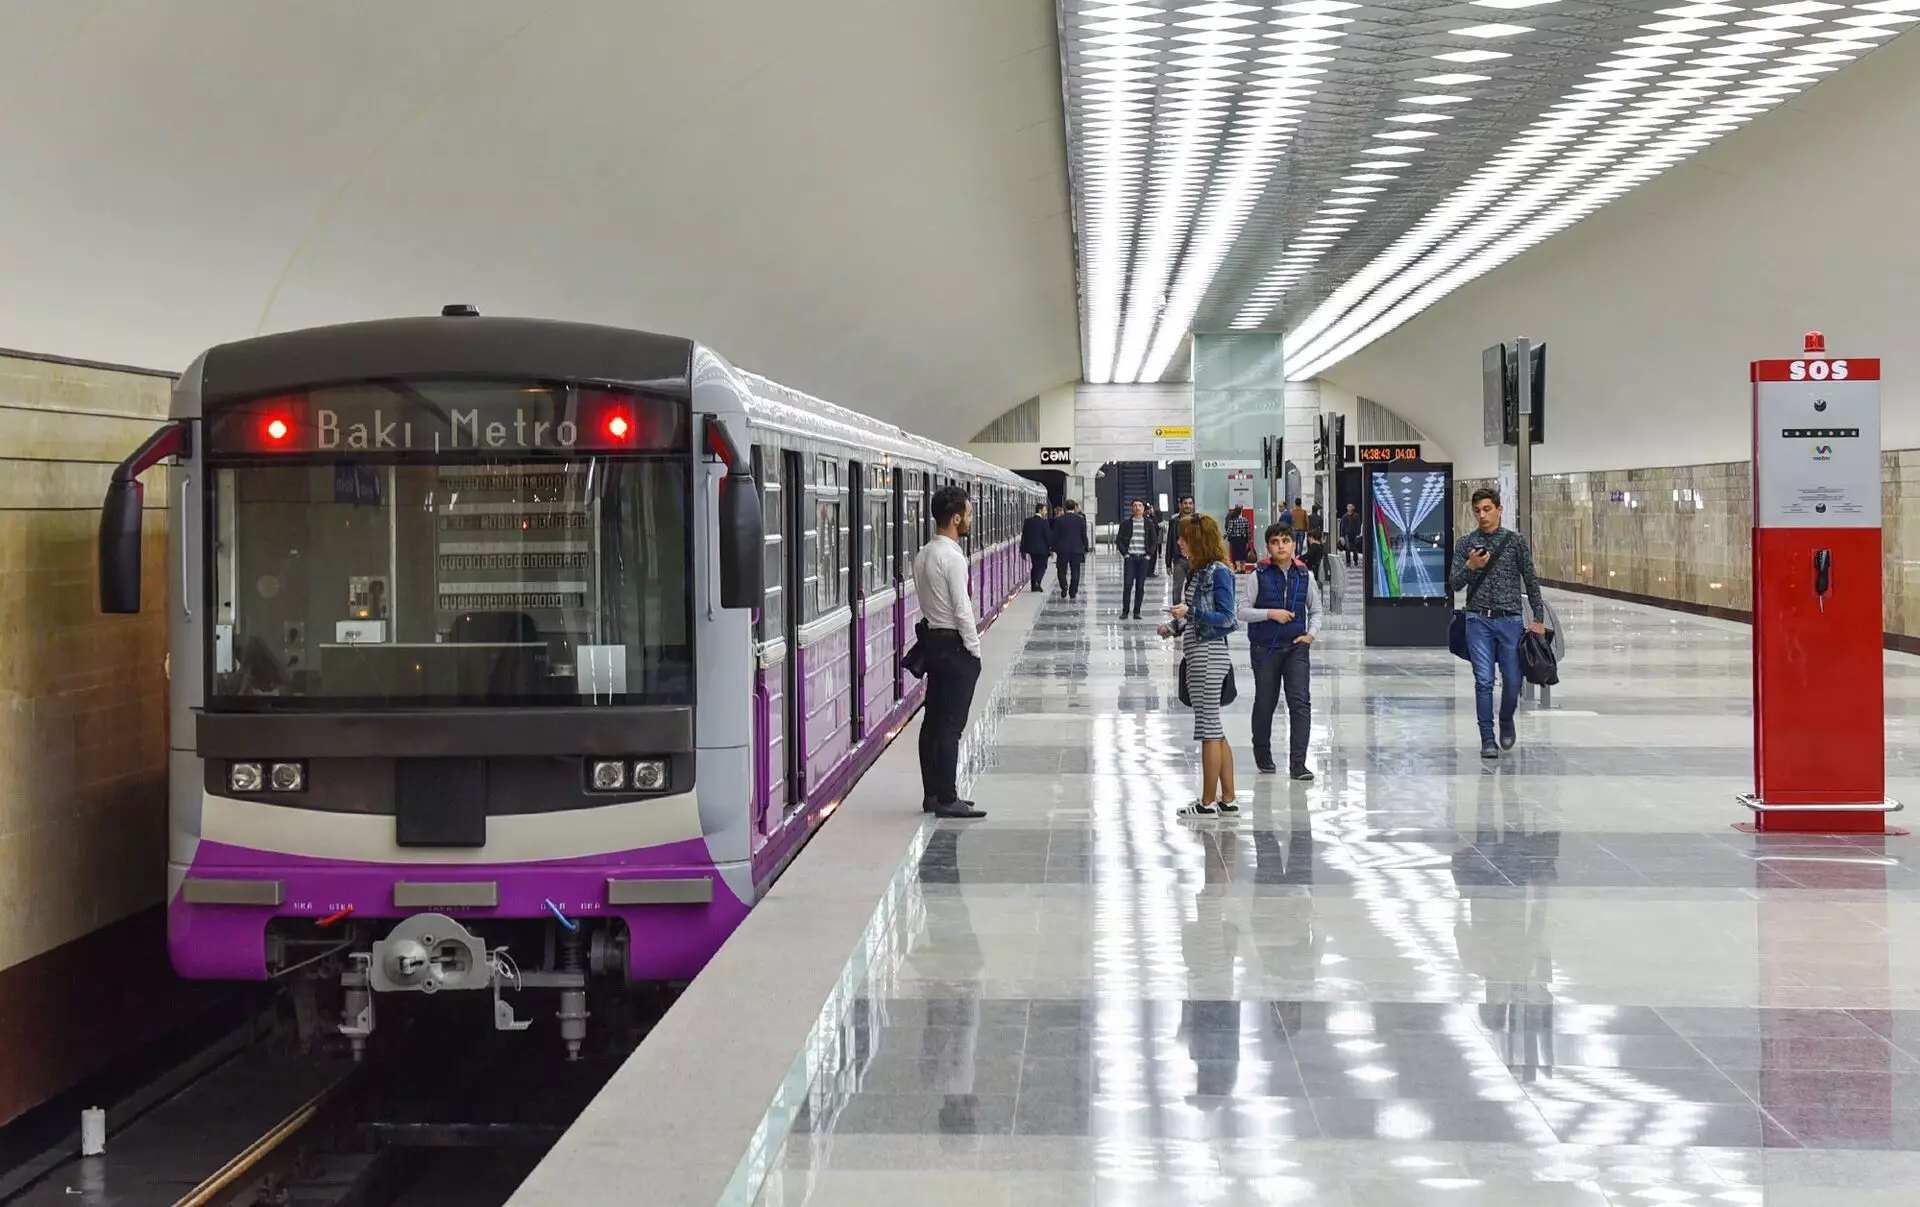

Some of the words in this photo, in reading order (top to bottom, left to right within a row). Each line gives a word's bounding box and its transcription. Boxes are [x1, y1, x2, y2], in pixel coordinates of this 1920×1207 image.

[1789, 360, 1848, 380] SOS
[317, 409, 411, 449] Bakı
[450, 408, 578, 448] Metro
[1360, 448, 1390, 460] 14:38:43
[1395, 448, 1416, 459] 04:00
